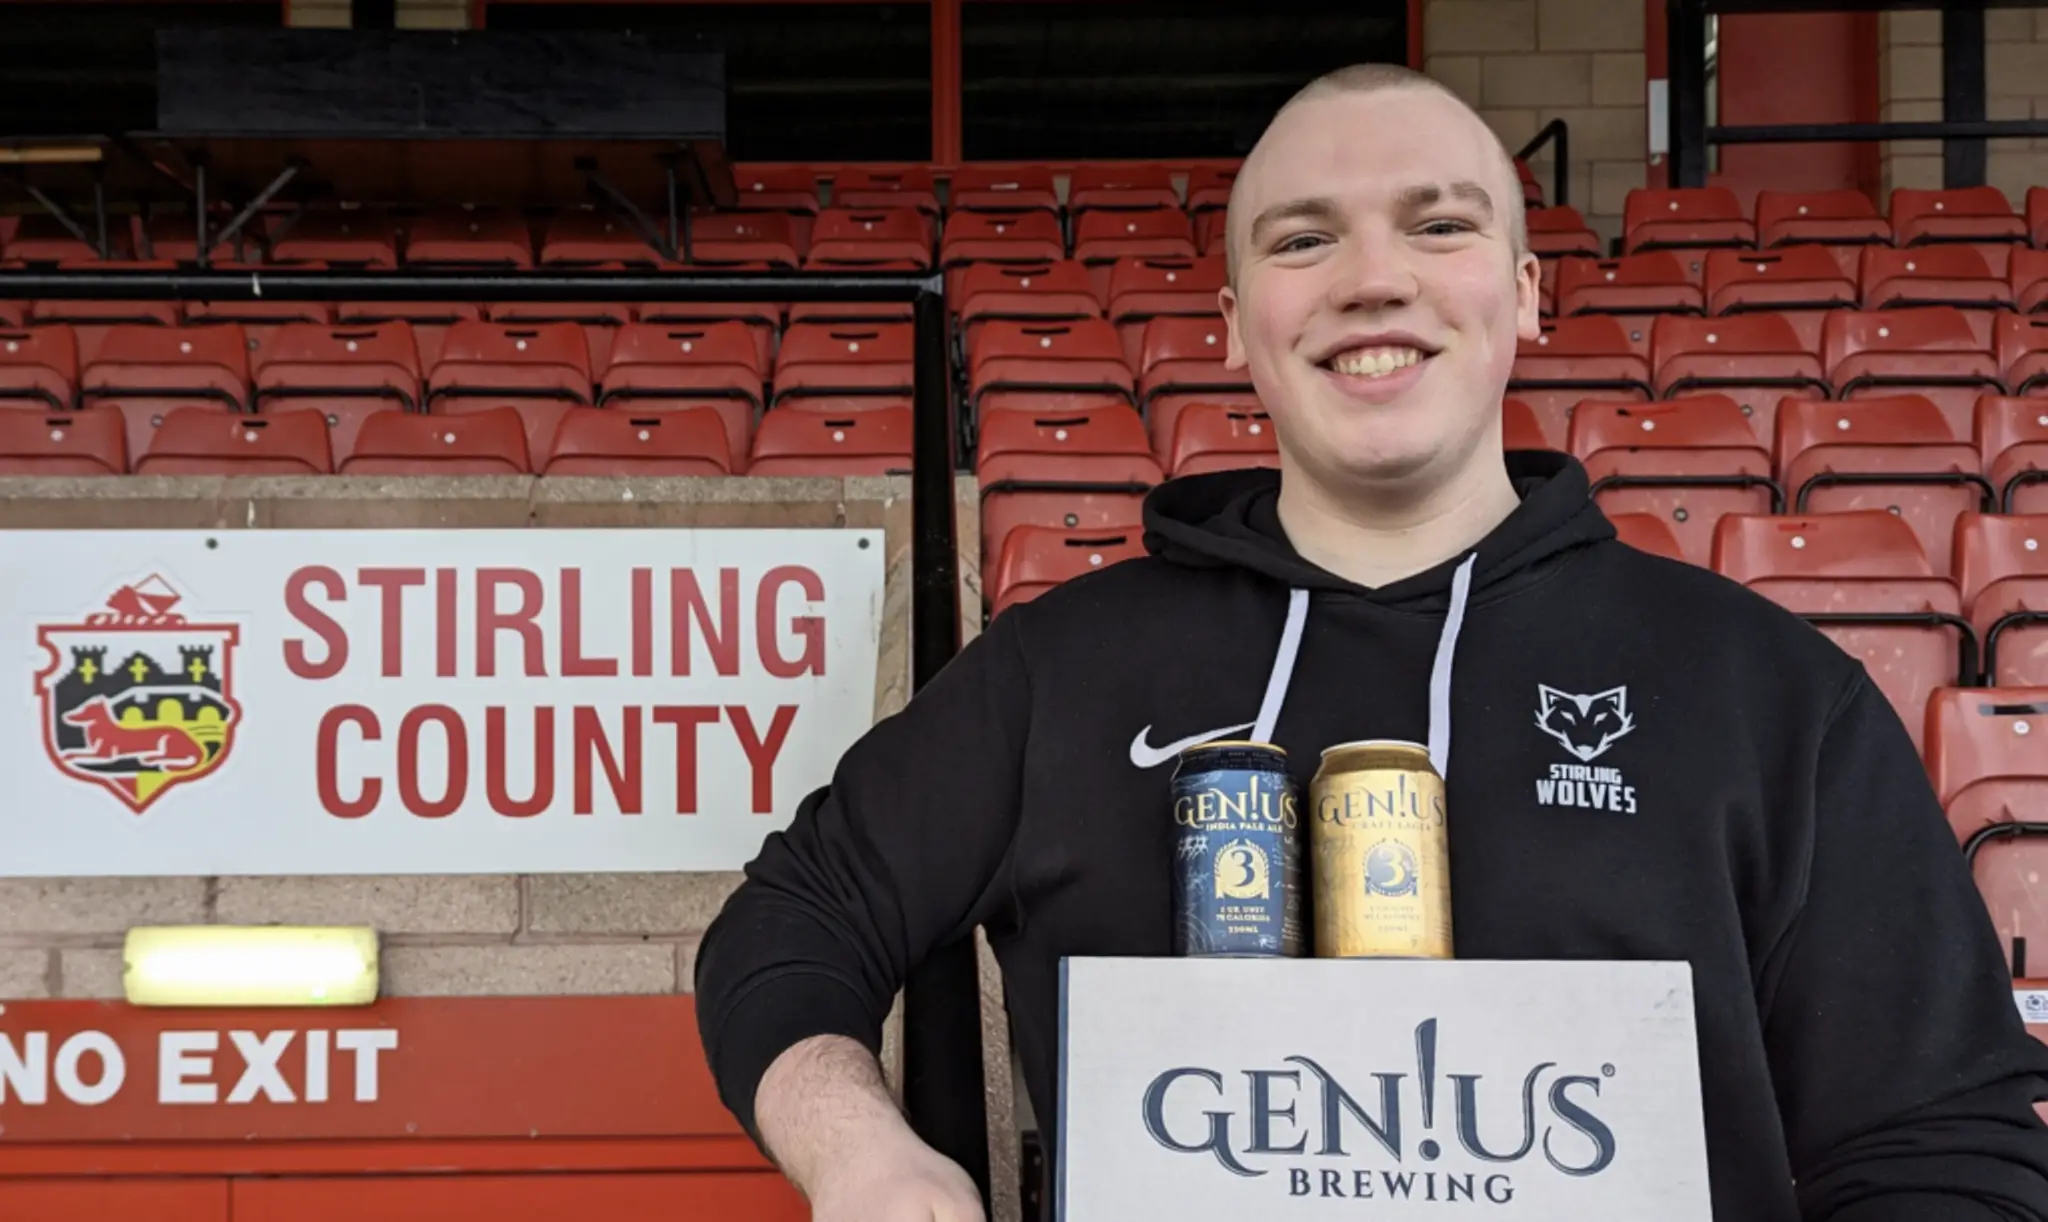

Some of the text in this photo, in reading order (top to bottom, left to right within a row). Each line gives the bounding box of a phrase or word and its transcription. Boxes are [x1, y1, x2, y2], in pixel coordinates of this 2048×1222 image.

[282, 564, 826, 680] STIRLING
[316, 703, 800, 819] COUNTY
[1549, 764, 1622, 785] STIRLING
[1174, 775, 1298, 829] GEN!US
[1318, 774, 1444, 827] GEN!US
[1535, 779, 1637, 814] WOLVES
[1206, 822, 1283, 833] INDIA PALE ALE
[1230, 850, 1255, 888] 3
[1380, 848, 1405, 888] 3
[0, 1029, 399, 1105] NO EXIT
[1288, 1167, 1516, 1204] BREWING
